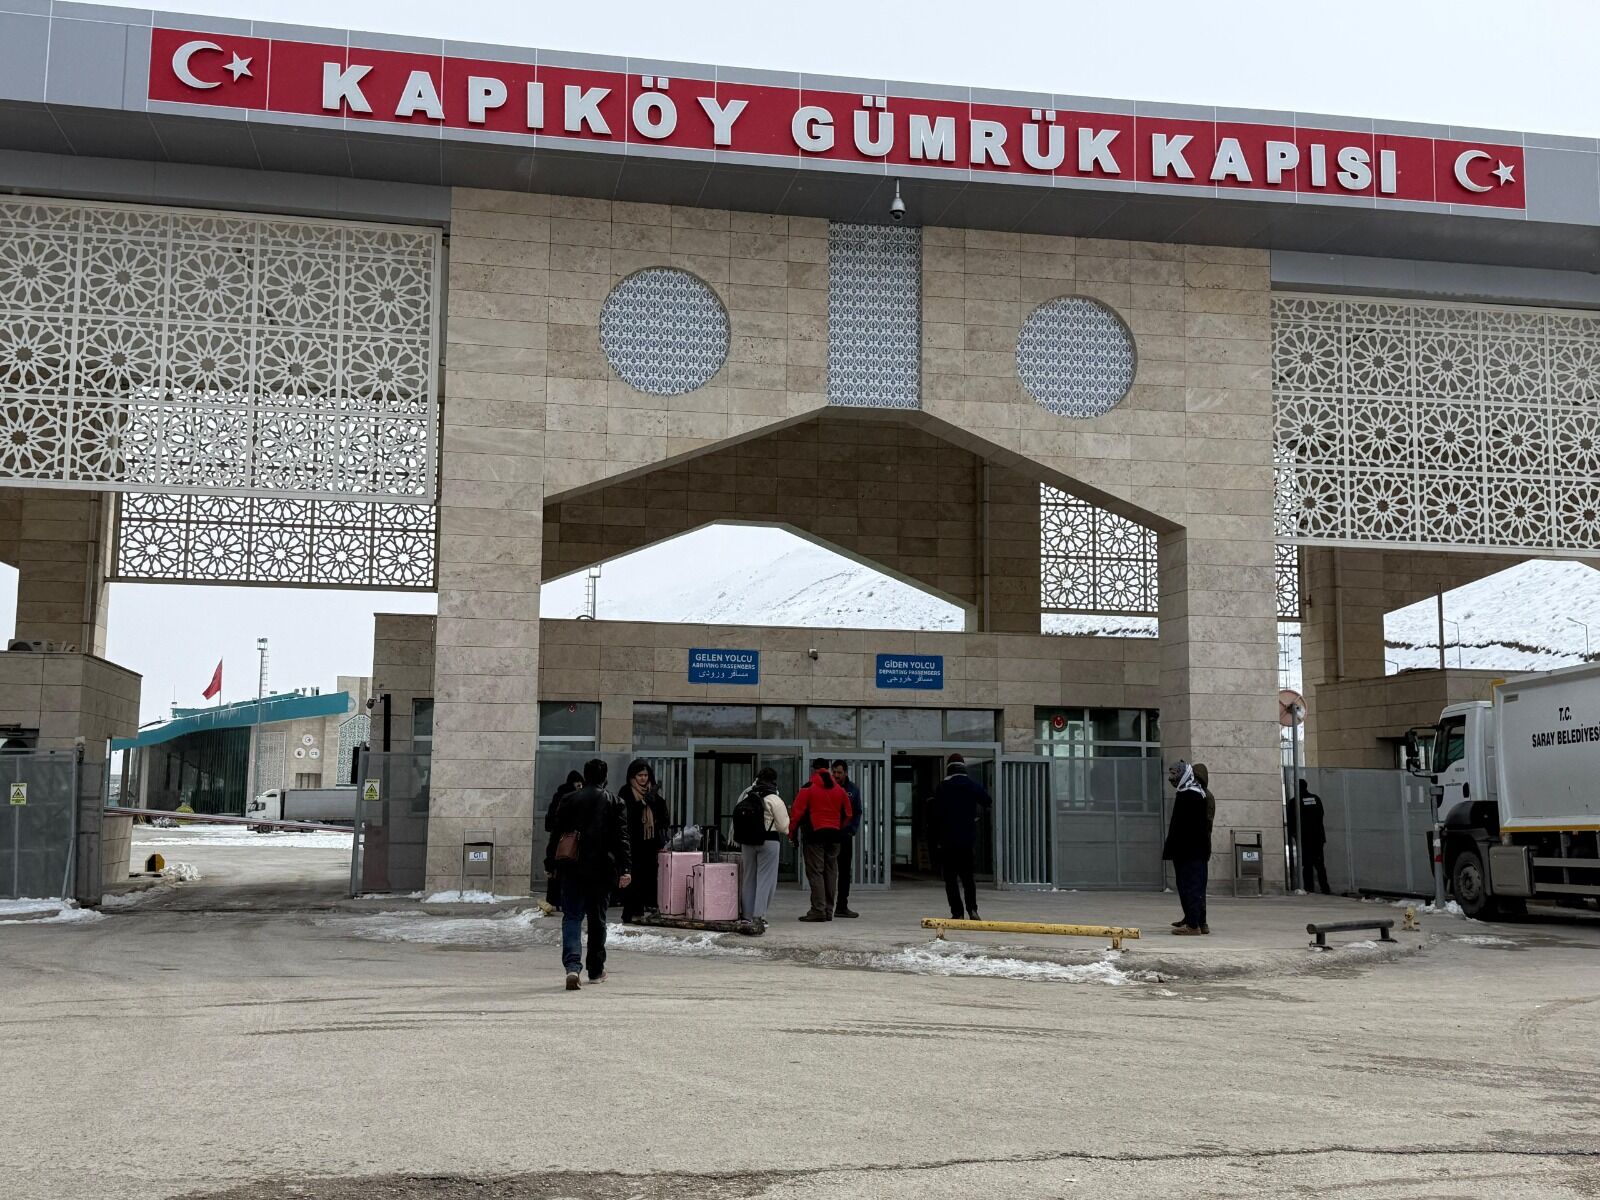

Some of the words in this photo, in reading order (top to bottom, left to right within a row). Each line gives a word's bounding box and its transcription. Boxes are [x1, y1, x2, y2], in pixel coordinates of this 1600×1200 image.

[322, 62, 749, 146] KAPIKÖY
[791, 96, 1121, 174] GÜMRÜK
[1152, 133, 1397, 194] KAPISI
[695, 653, 723, 662] GELEN
[724, 654, 753, 663] YOLCU
[884, 659, 909, 669] GİDEN
[910, 661, 936, 670] YOLCU
[1558, 706, 1572, 721] T.C.
[1531, 731, 1555, 748] SARAY
